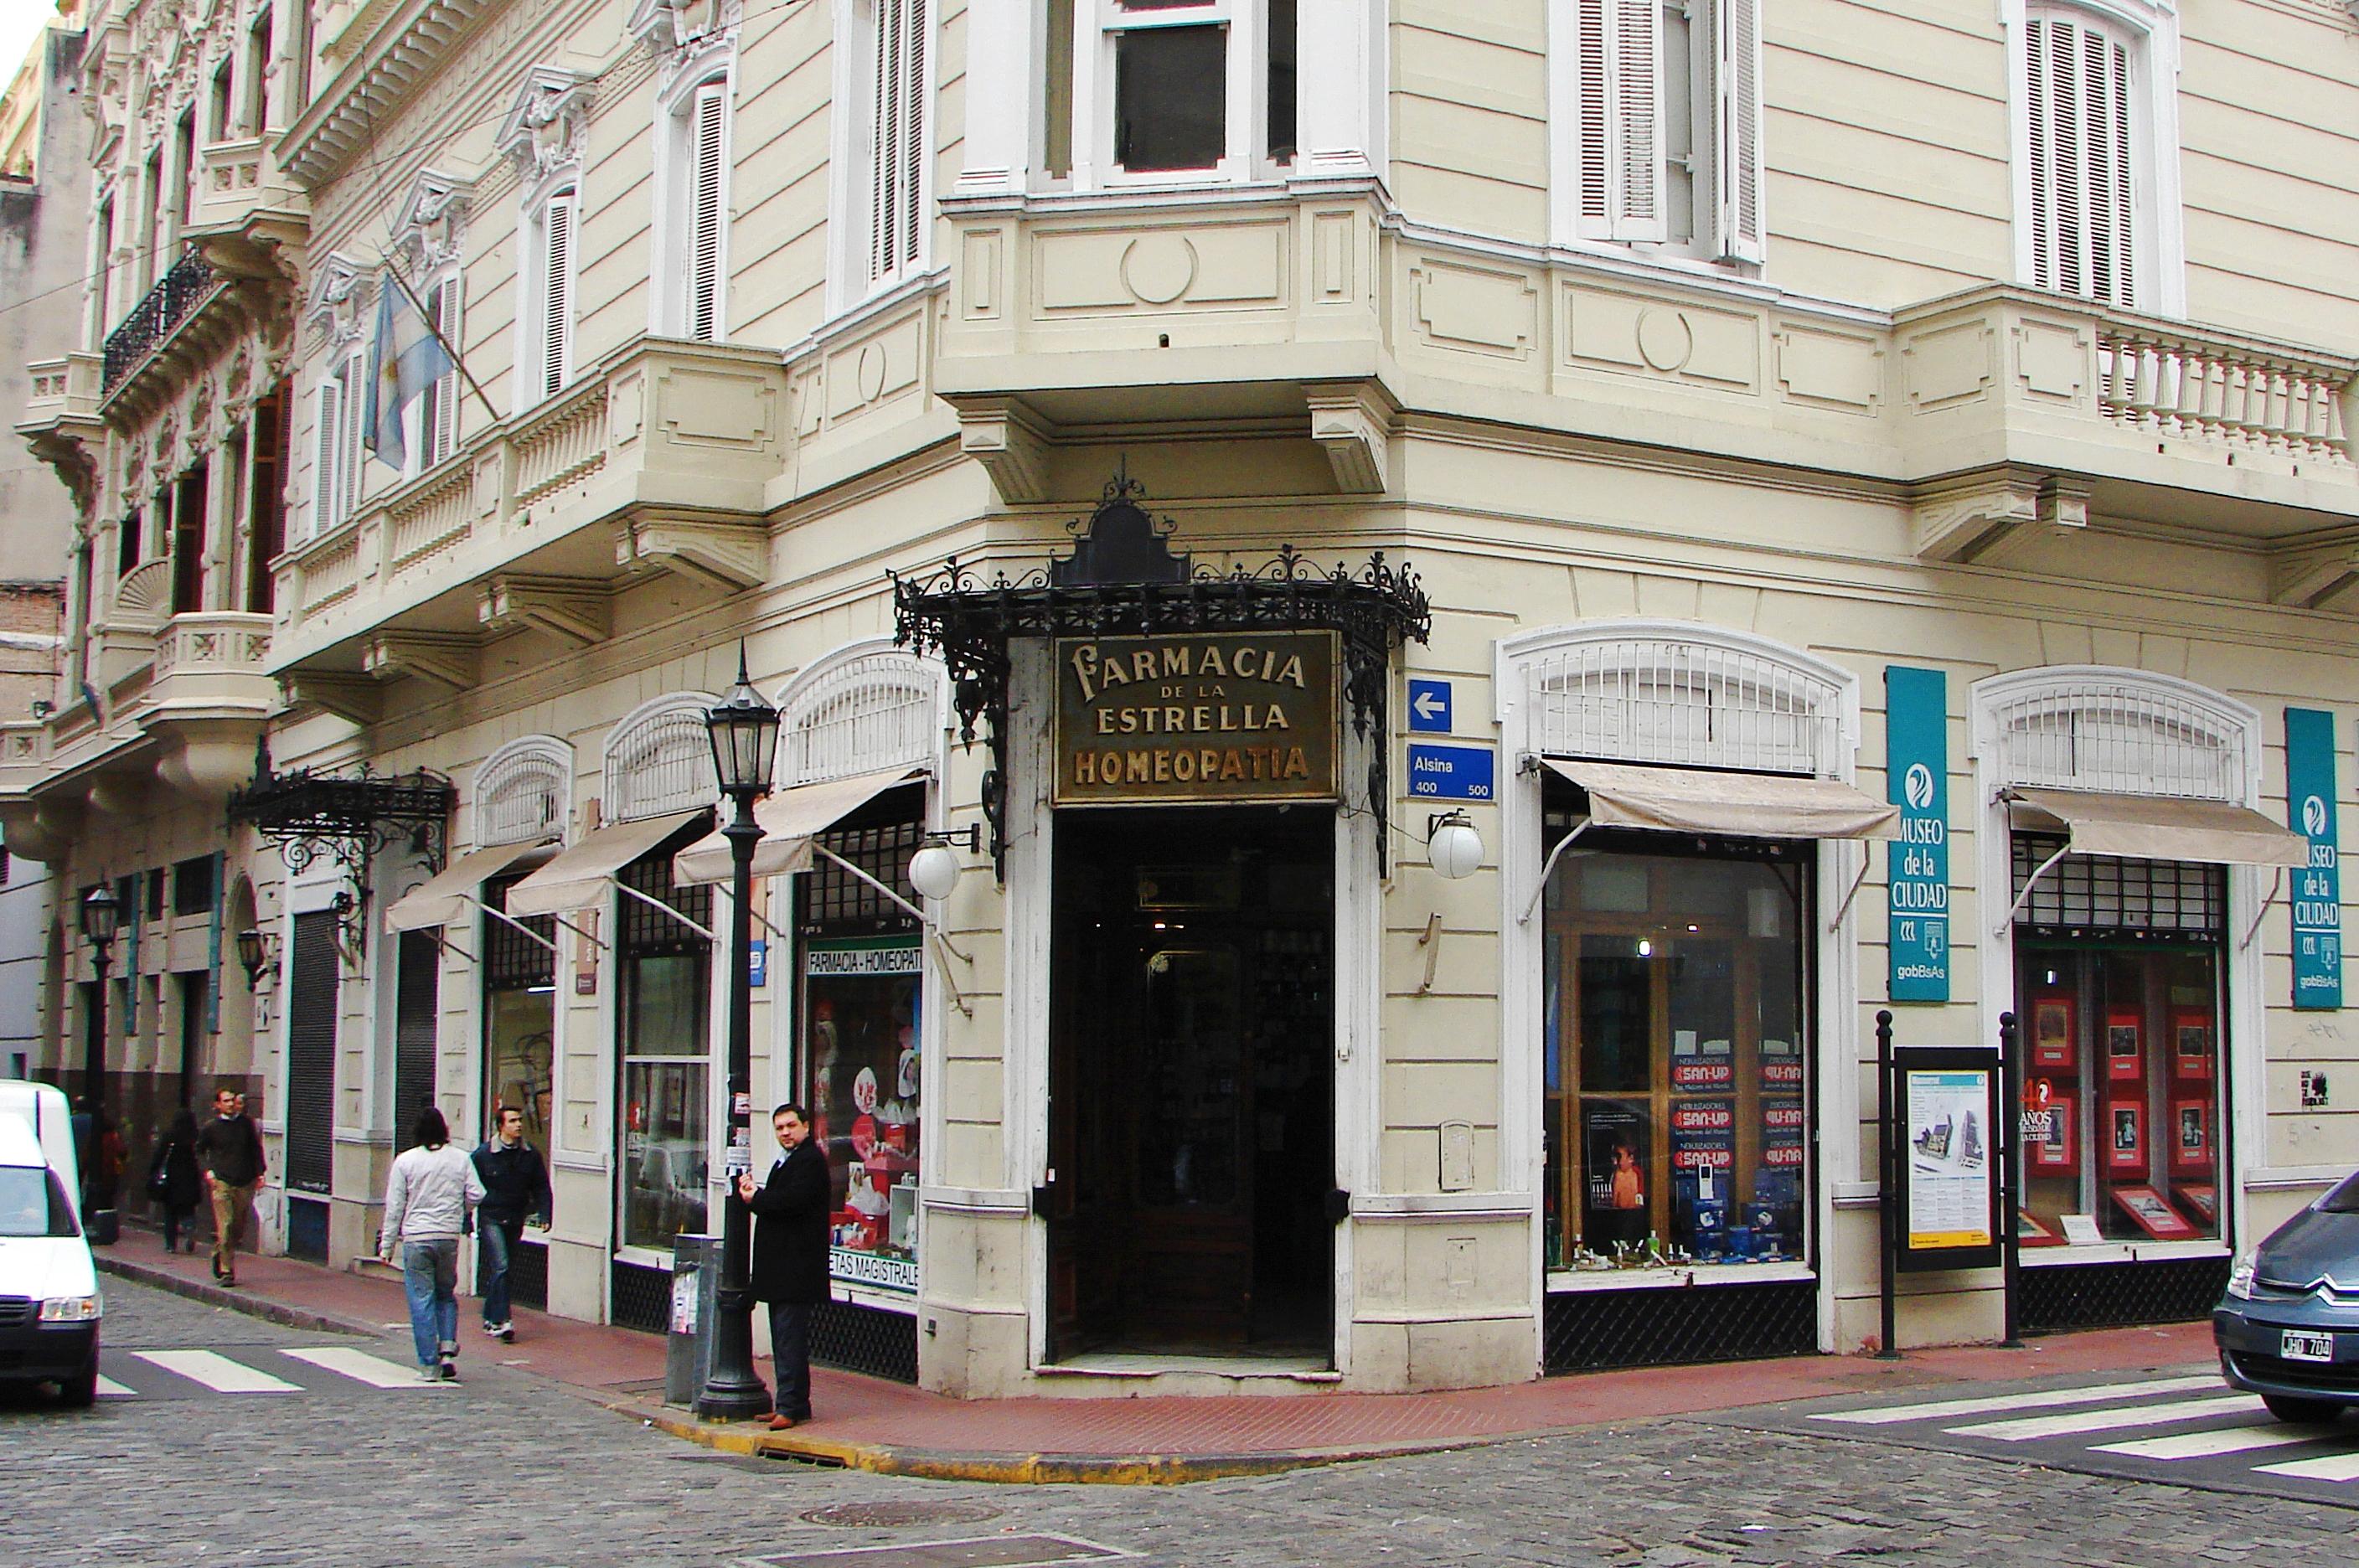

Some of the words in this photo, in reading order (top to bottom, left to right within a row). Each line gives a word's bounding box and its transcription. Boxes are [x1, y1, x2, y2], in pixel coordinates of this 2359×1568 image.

[1071, 645, 1305, 703] FARMACIA
[1160, 685, 1184, 699] DE
[1198, 685, 1225, 698] LA
[1097, 704, 1289, 735] ESTRELLA
[1075, 747, 1309, 785] HOMEOPATIA
[1414, 756, 1453, 773] Alsina
[1416, 781, 1438, 794] 400
[1468, 785, 1489, 796] 500
[1904, 848, 1920, 876] de
[1923, 848, 1934, 877] la
[2306, 844, 2336, 869] USEO
[2304, 871, 2317, 896] de
[2319, 872, 2330, 897] la
[1892, 881, 1947, 909] CIUDAD
[2294, 901, 2339, 926] CIUDAD
[810, 952, 859, 972] FARMACIA
[1897, 964, 1945, 979] gobBsAs
[2300, 974, 2339, 989] gobBsAs
[1683, 1066, 1729, 1081] SAN-UP
[1682, 1112, 1729, 1126] SAN-UP
[2019, 1110, 2052, 1125] AÑOS
[1684, 1152, 1730, 1165] SAN-UP
[2310, 1339, 2330, 1355] 704
